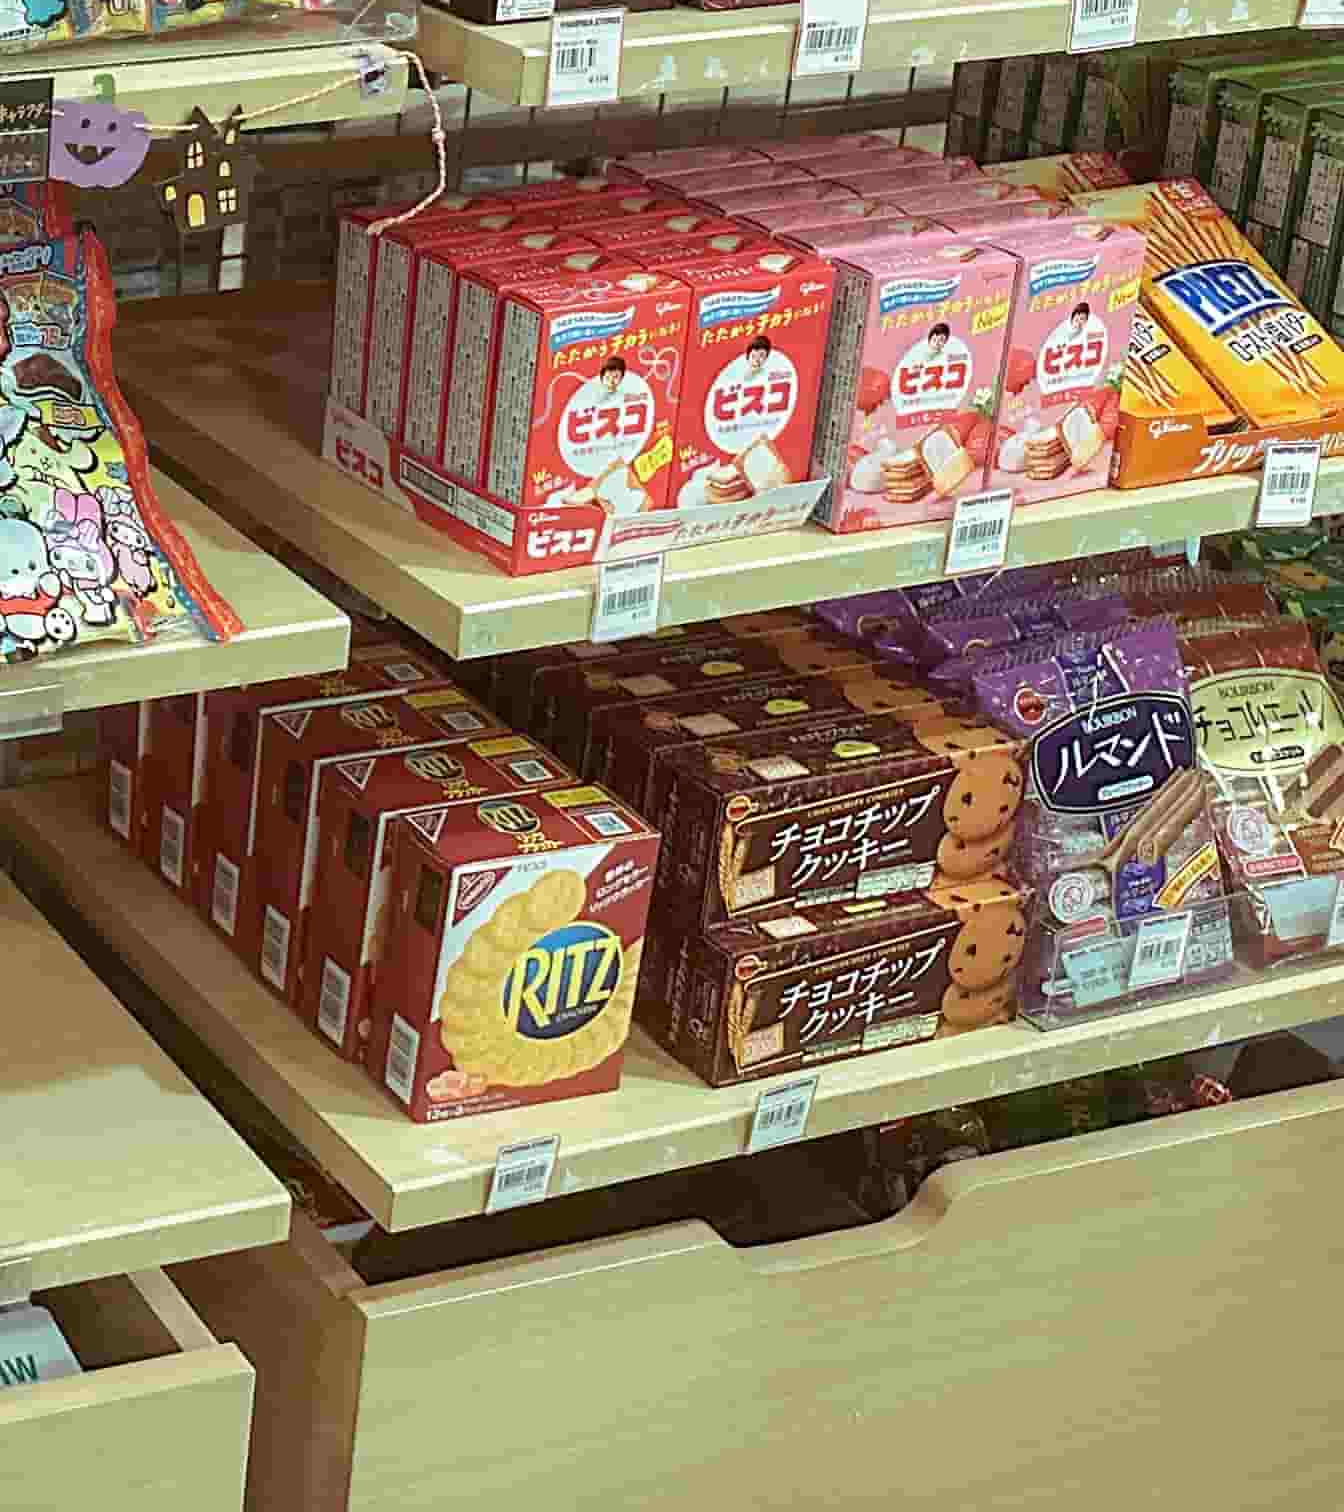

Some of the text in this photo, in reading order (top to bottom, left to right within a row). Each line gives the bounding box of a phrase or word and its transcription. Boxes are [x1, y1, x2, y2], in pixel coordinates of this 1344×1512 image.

[1165, 263, 1282, 328] PRETZ
[898, 360, 969, 394] ビスコ
[1043, 340, 1104, 373] ビスコ
[567, 403, 649, 445] ビスコ
[713, 381, 792, 421] ビスコ
[527, 528, 595, 558] ビスコ
[1050, 710, 1186, 795] ルマンド
[769, 785, 944, 861] チョコチップ
[791, 837, 911, 889] クッキー
[507, 936, 620, 1029] RITZ
[780, 937, 947, 1016] チョコチップ
[799, 991, 915, 1042] クッキー
